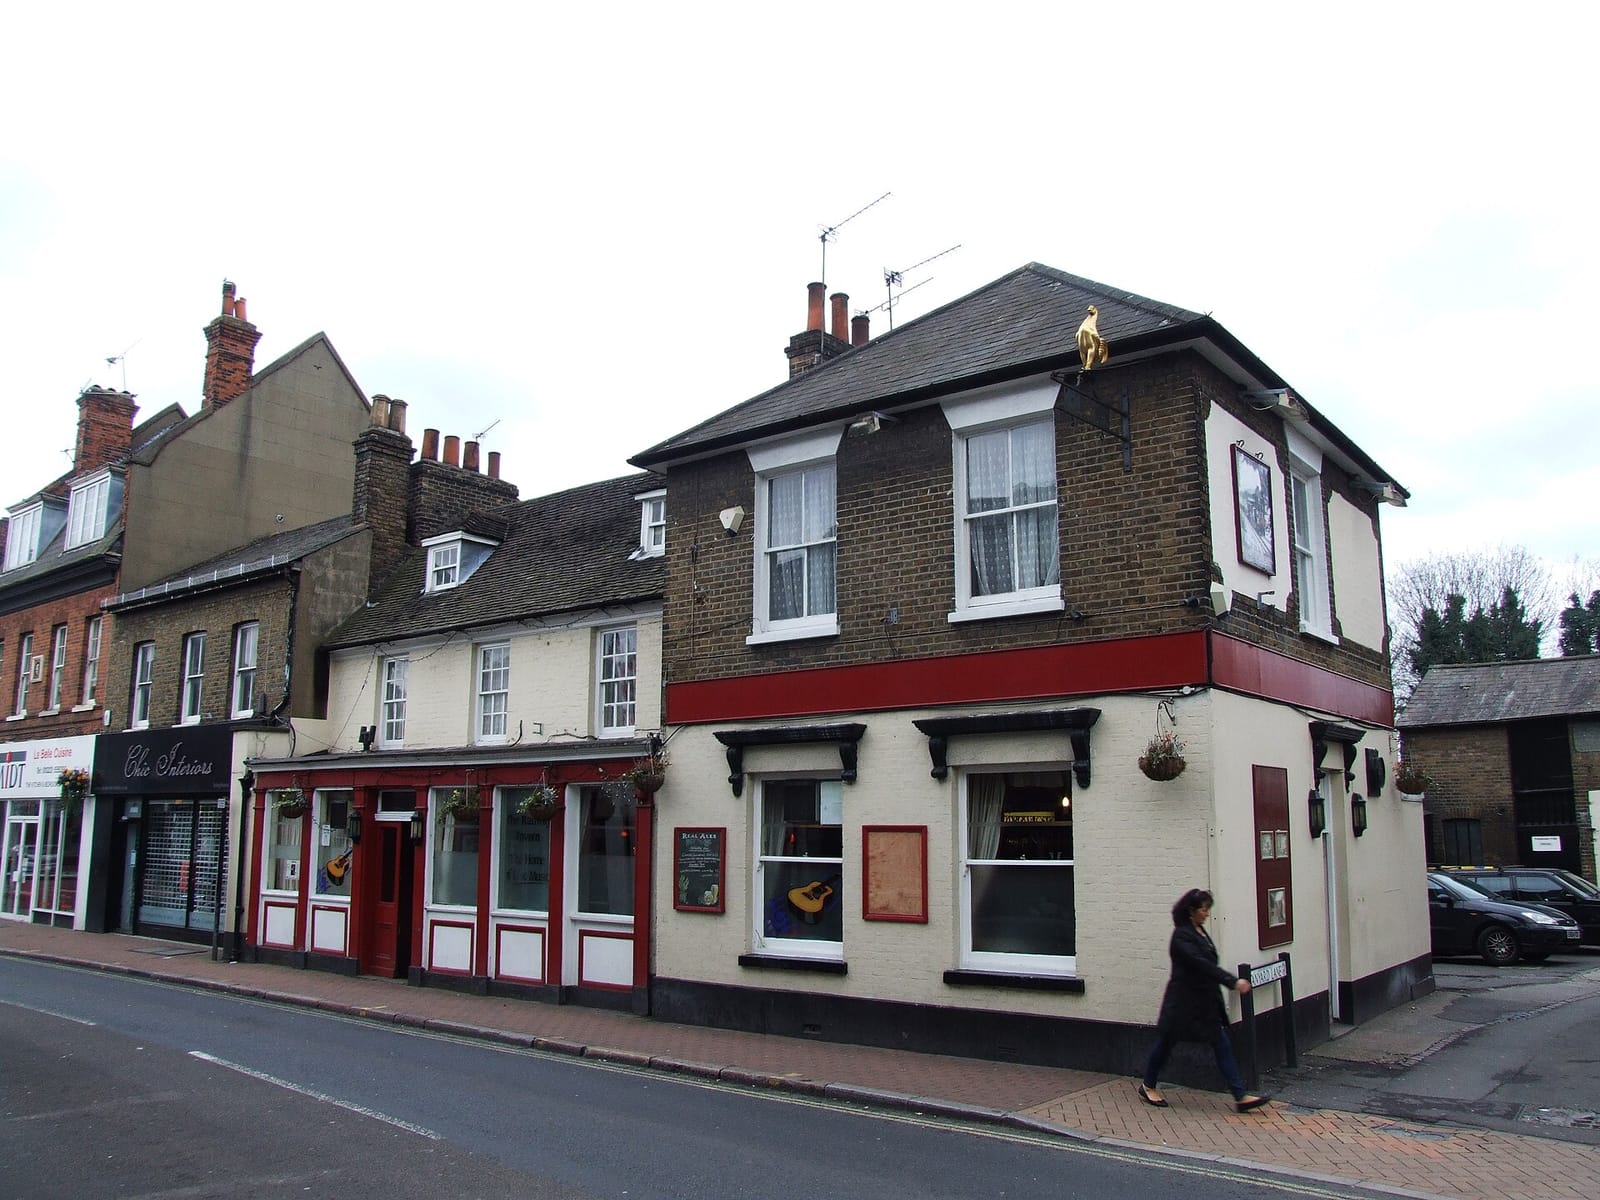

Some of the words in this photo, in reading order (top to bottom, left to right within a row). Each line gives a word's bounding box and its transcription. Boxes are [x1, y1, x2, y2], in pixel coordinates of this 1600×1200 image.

[33, 750, 40, 760] La
[41, 748, 53, 759] Belle
[54, 747, 73, 758] Cuisine
[124, 744, 152, 778] Chic
[156, 742, 213, 777] Interiors
